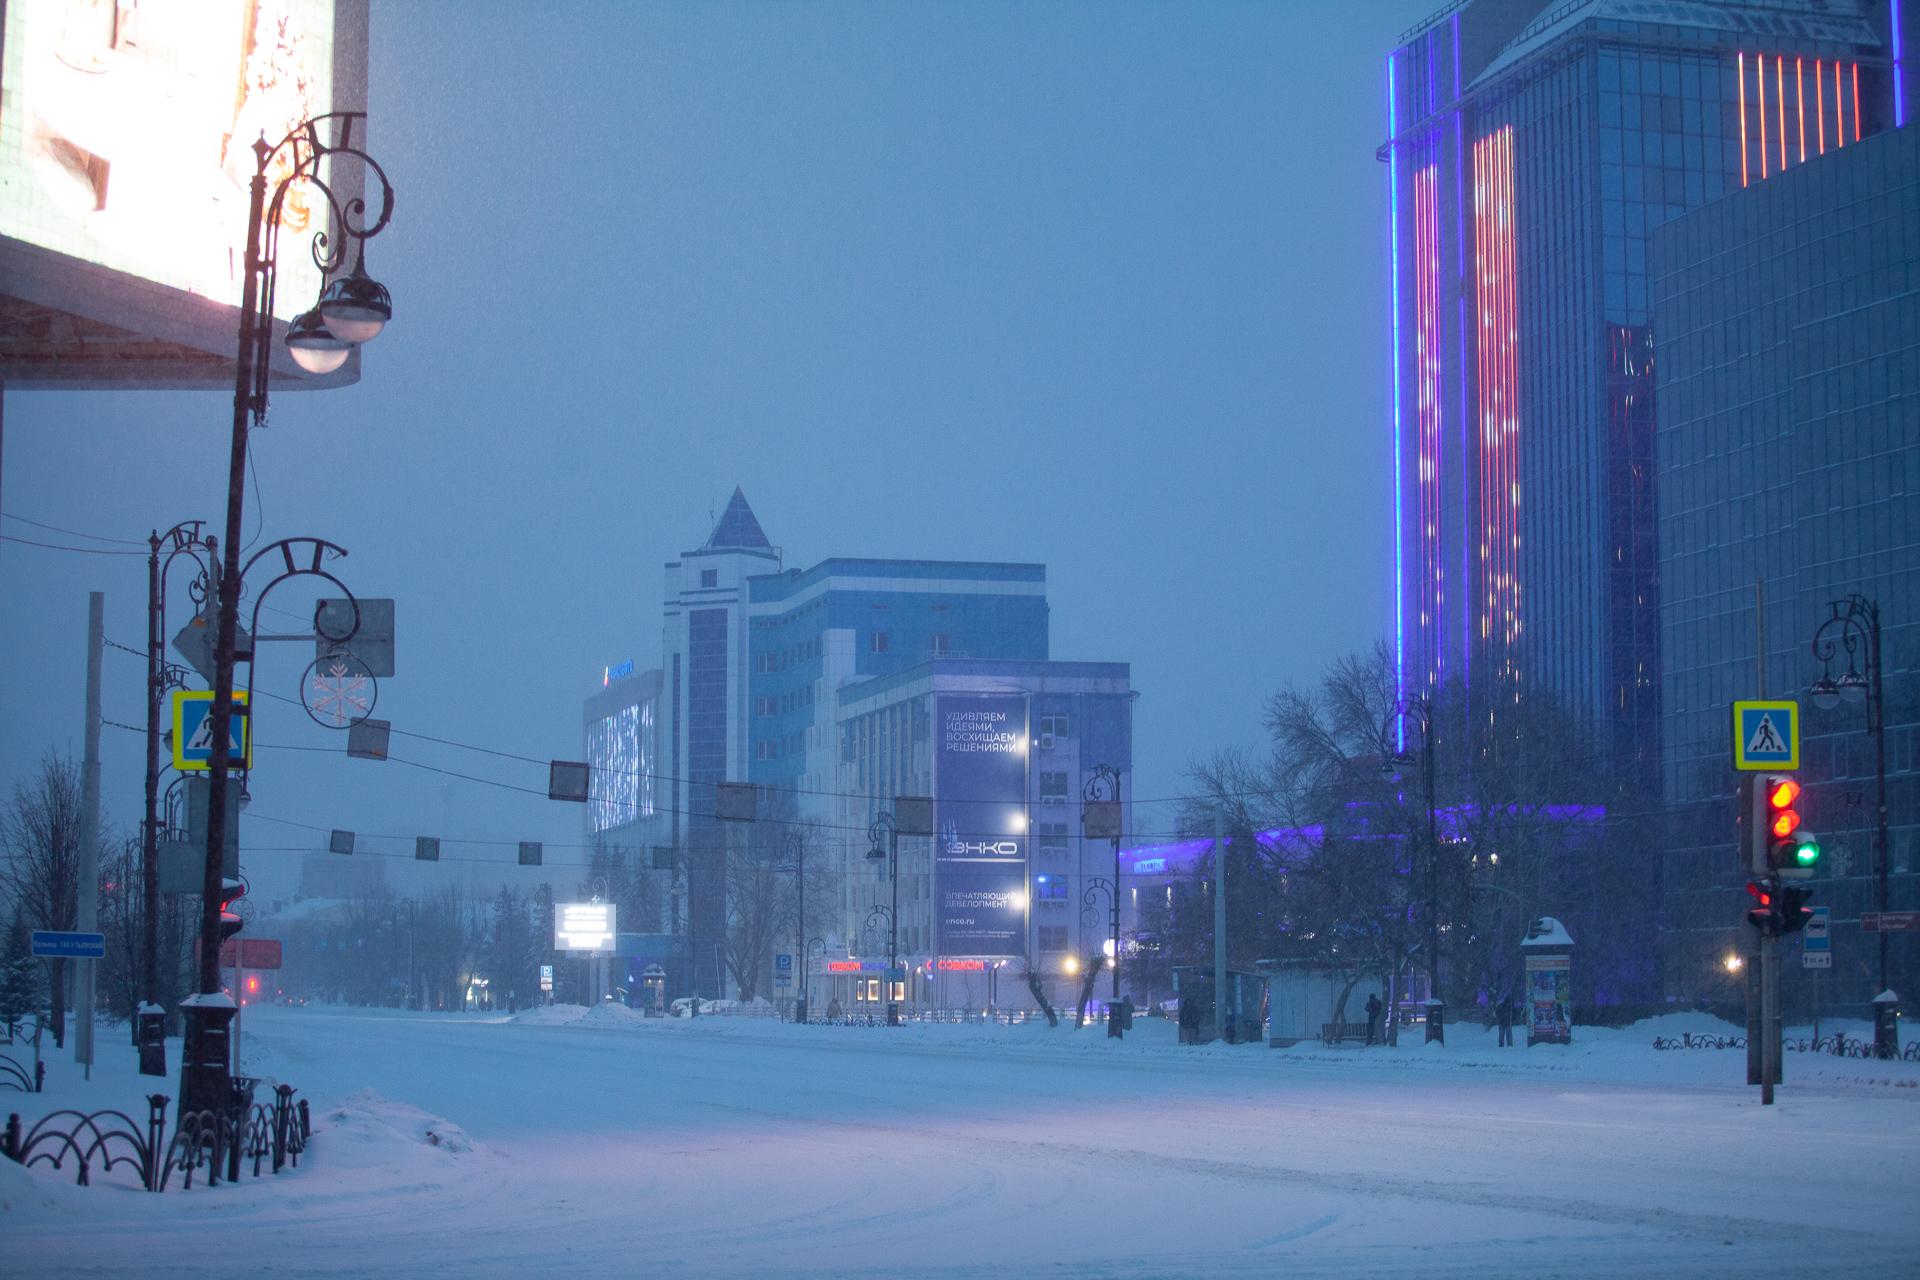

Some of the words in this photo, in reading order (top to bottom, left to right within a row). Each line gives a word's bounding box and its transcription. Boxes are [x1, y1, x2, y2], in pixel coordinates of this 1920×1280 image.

[946, 712, 1006, 721] УДИВЛЯЕМ
[946, 722, 995, 732] ИДЕЯМИ,
[946, 732, 1016, 742] ВОСХИЩАЕМ
[946, 743, 1016, 752] РЕШЕНИЯМИ
[948, 841, 1018, 855] ЭНКО
